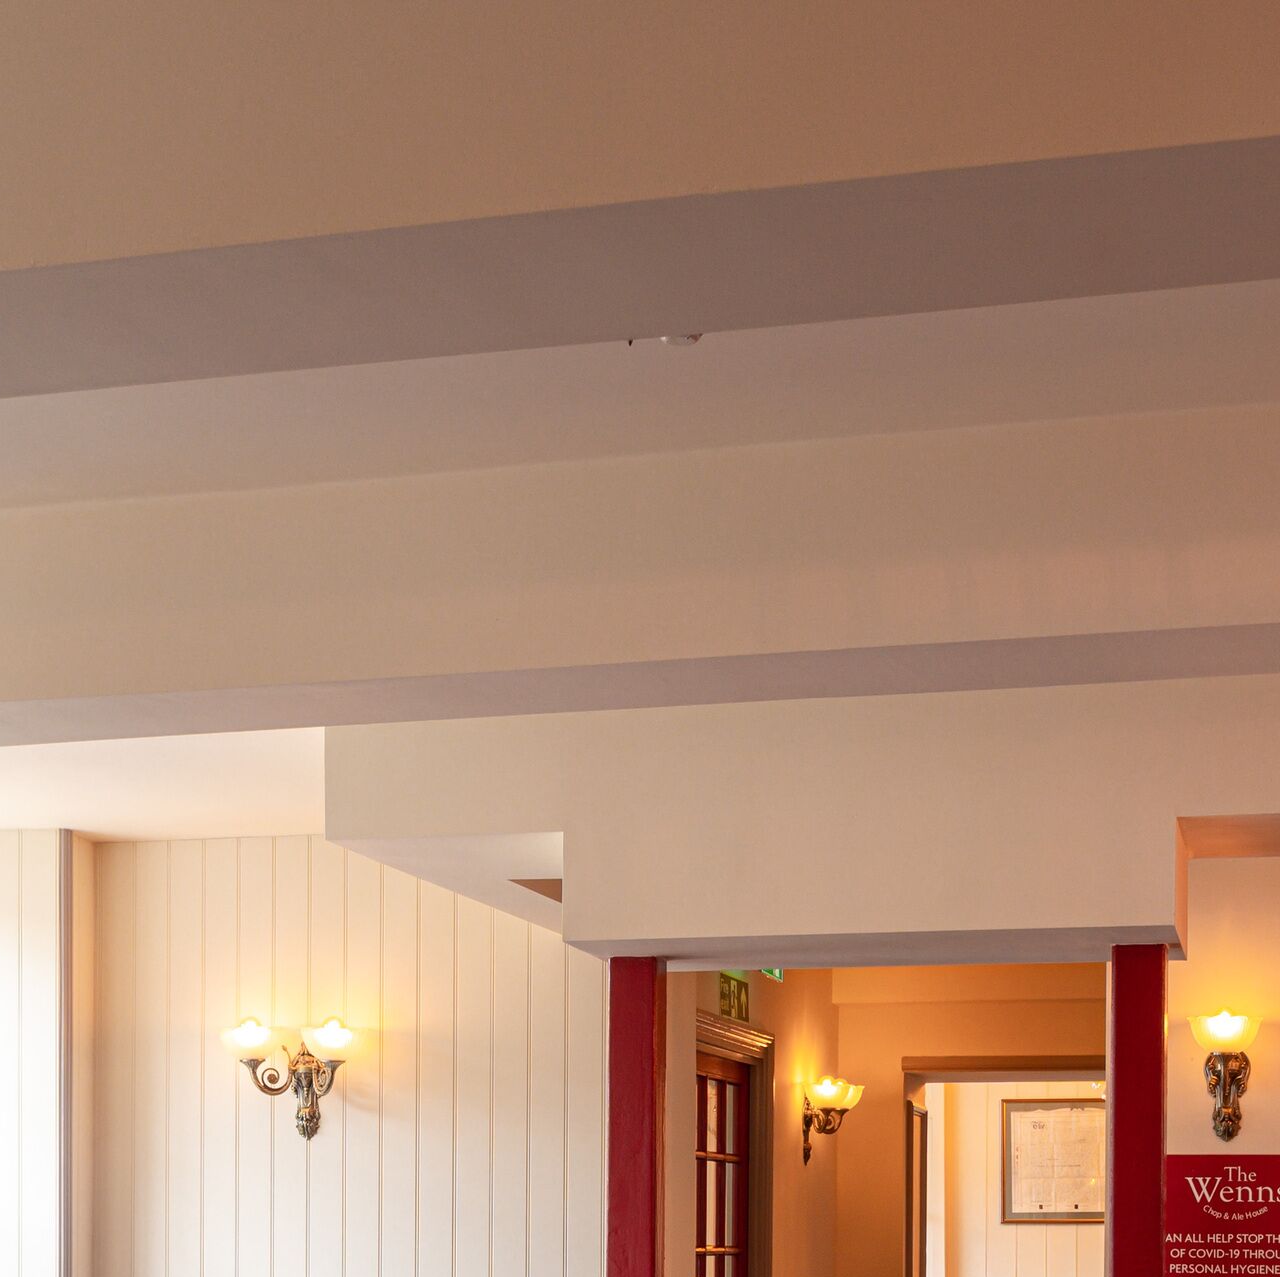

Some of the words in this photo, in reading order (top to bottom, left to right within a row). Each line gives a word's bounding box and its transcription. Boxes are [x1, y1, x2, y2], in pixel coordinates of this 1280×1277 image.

[1223, 1166, 1257, 1182] The
[1203, 1205, 1222, 1219] Chop
[1223, 1212, 1230, 1220] &
[1231, 1212, 1245, 1221] Ale
[1245, 1206, 1269, 1219] House
[1165, 1233, 1182, 1243] AN
[1184, 1233, 1204, 1243] ALL
[1207, 1233, 1233, 1243] HELP
[1236, 1233, 1264, 1244] STOP
[1170, 1249, 1186, 1259] OF
[1188, 1249, 1240, 1259] COVID-19
[1169, 1264, 1228, 1274] PERSONAL
[1230, 1264, 1280, 1275] HYGIENE
